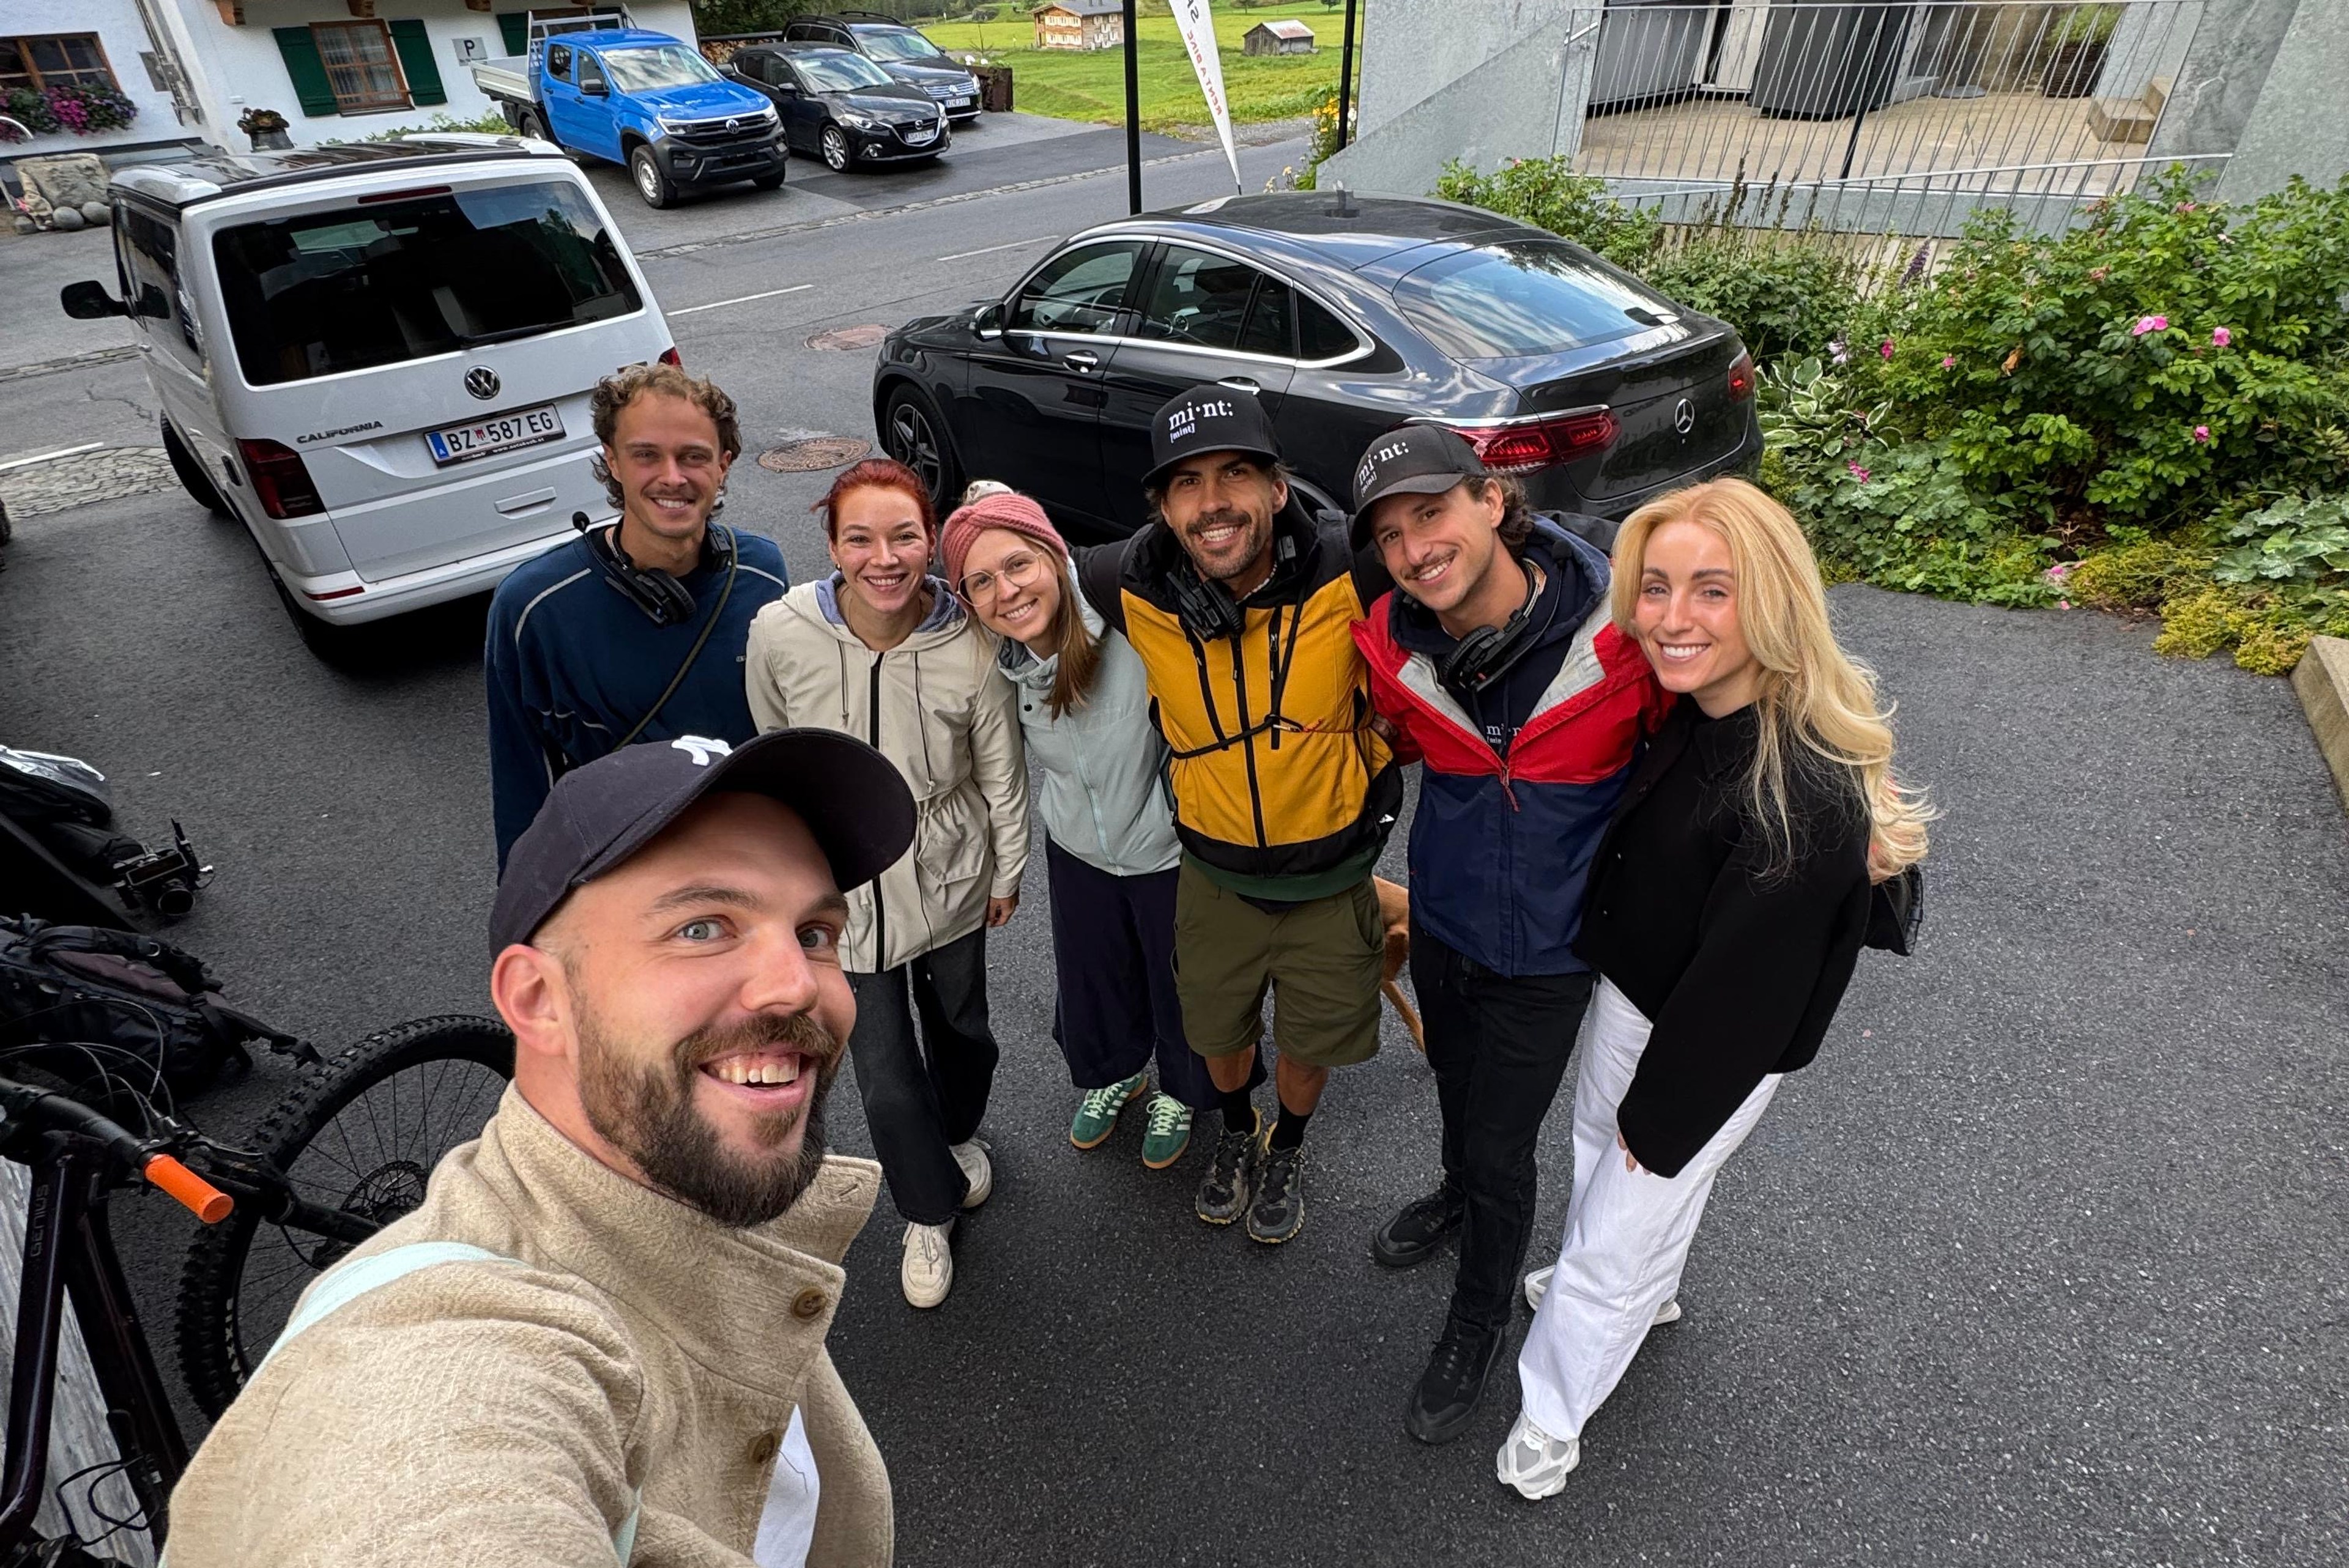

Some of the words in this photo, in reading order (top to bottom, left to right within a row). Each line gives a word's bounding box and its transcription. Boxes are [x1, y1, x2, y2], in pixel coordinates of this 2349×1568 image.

[464, 40, 475, 57] P
[297, 421, 384, 443] CALIFORNIA
[447, 430, 477, 453] BZ
[486, 418, 522, 443] 587
[527, 412, 554, 434] EG
[30, 1184, 49, 1257] GENIUS
